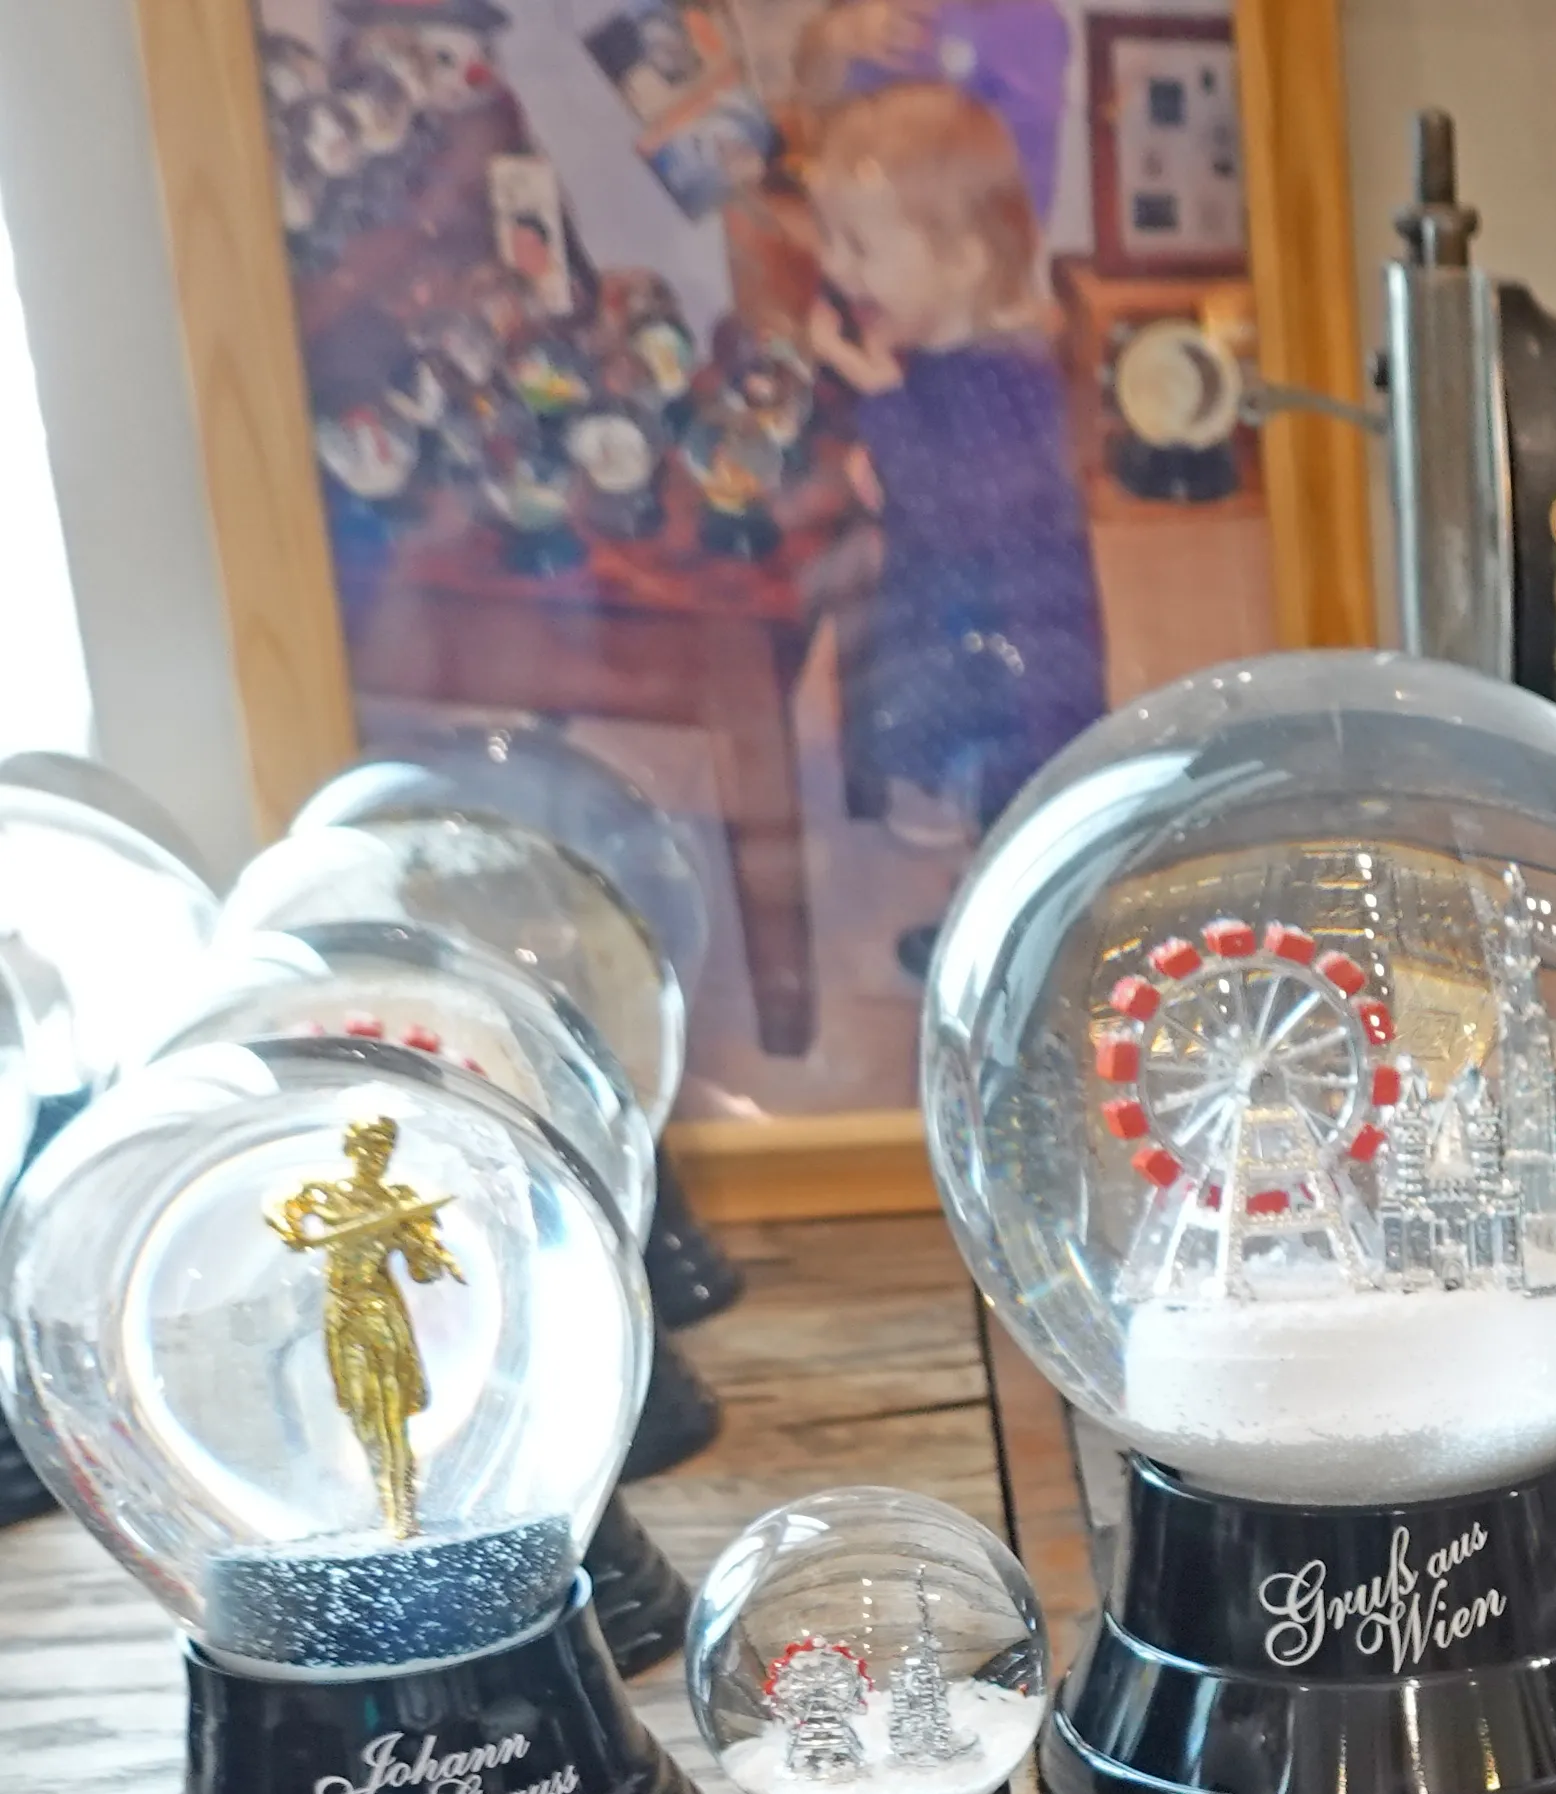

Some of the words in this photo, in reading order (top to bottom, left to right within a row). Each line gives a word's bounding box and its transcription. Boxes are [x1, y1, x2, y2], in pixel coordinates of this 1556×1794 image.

[1258, 1526, 1418, 1666] Gruß
[1427, 1521, 1487, 1578] aus
[1356, 1578, 1506, 1674] Wien
